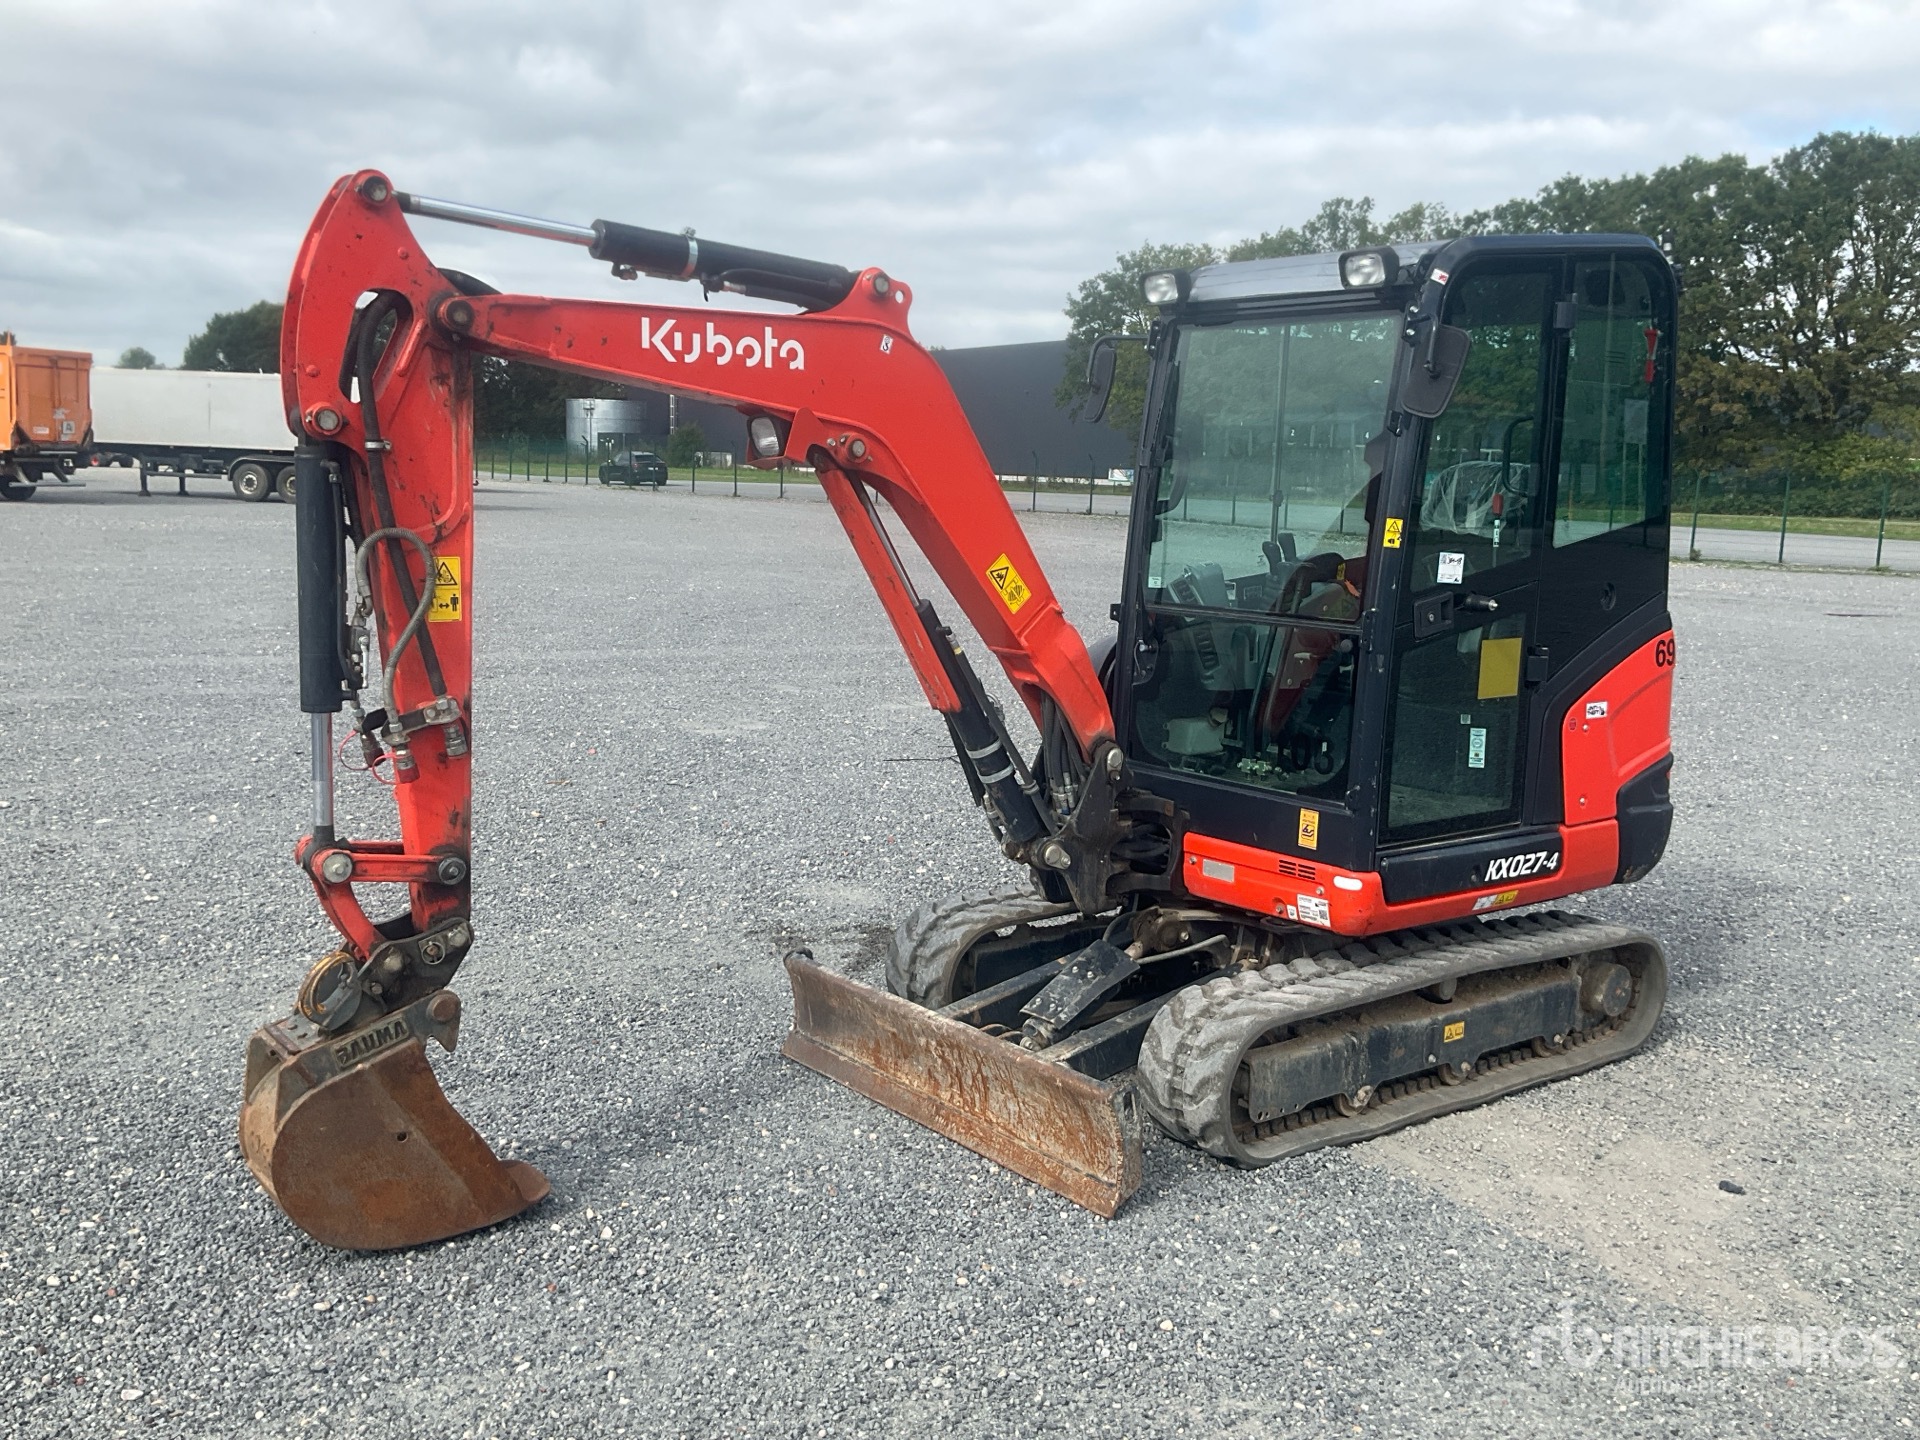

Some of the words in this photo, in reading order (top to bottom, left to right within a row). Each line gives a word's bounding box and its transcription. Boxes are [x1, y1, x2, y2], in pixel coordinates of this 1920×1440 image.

[641, 316, 805, 370] Kubota
[1655, 638, 1676, 668] 69
[1484, 851, 1559, 882] KX027-4
